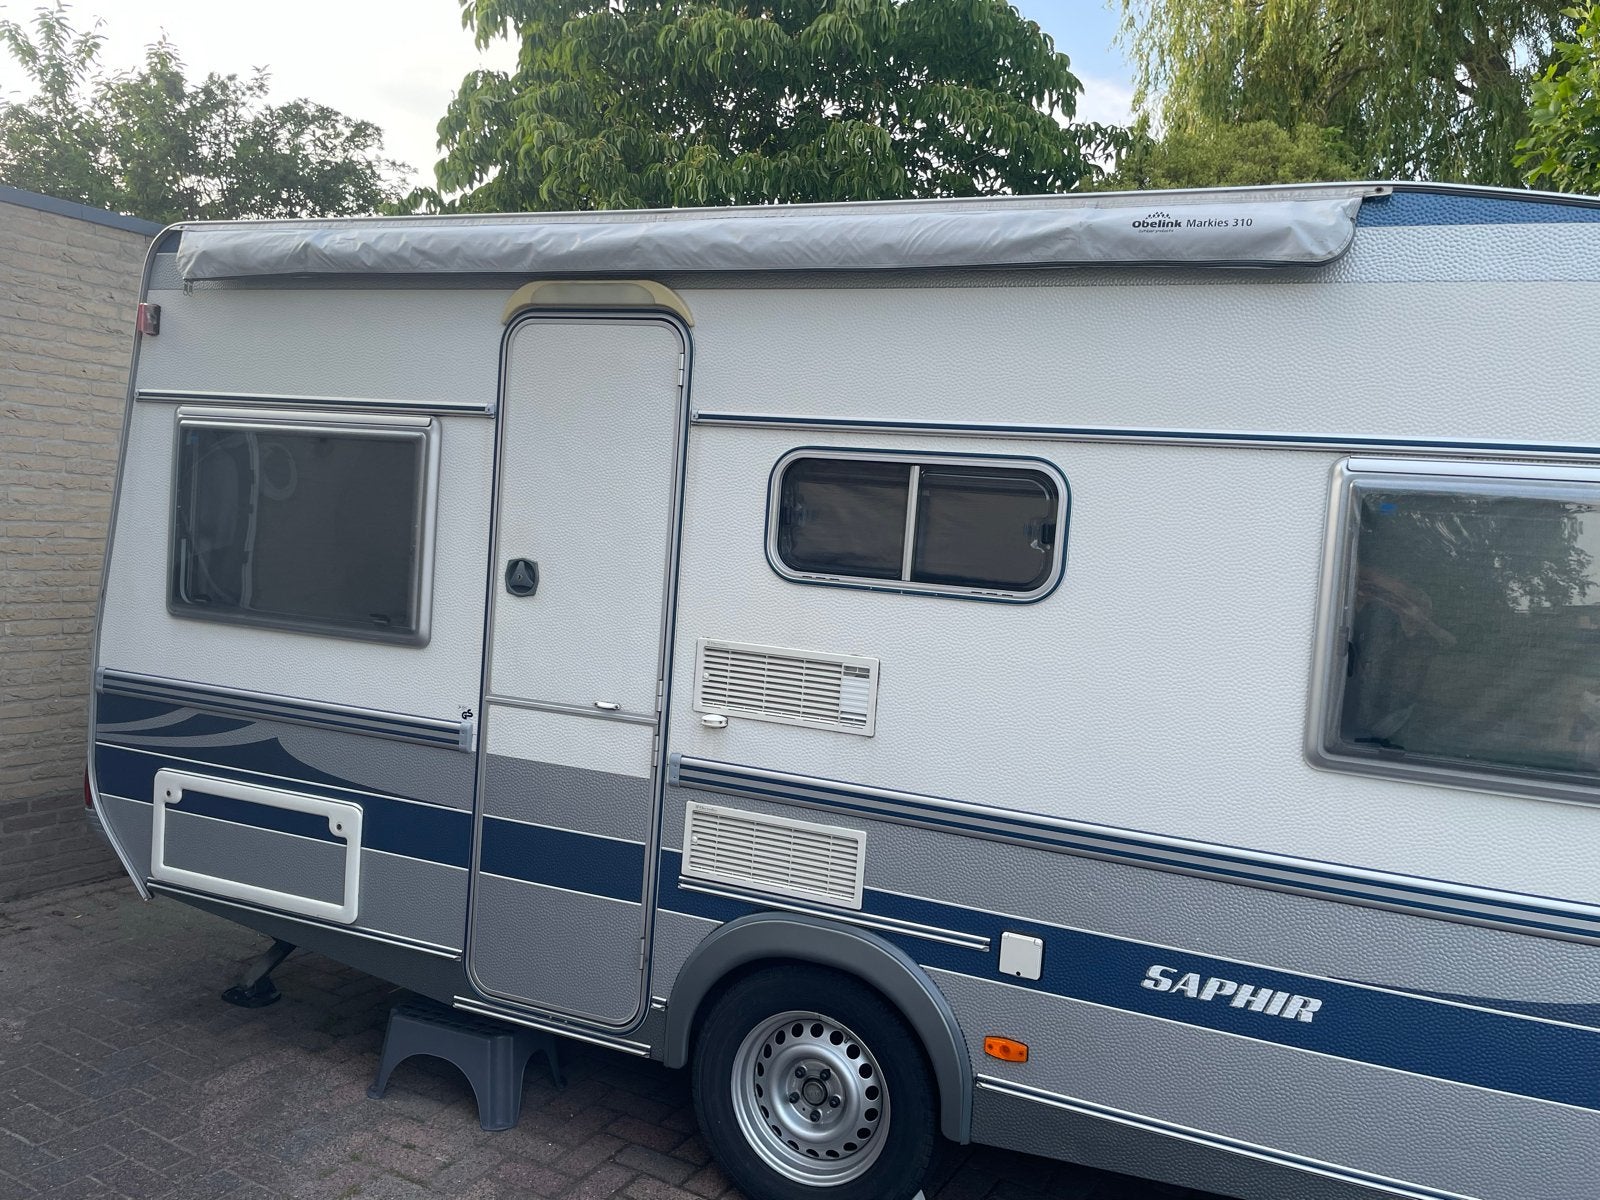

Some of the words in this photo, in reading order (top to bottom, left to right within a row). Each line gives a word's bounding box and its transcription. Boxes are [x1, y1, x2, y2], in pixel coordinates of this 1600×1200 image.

[1132, 219, 1182, 228] Obelink
[1186, 218, 1229, 228] Markies
[1232, 218, 1253, 227] 310
[1140, 964, 1323, 1023] SAPHIR
